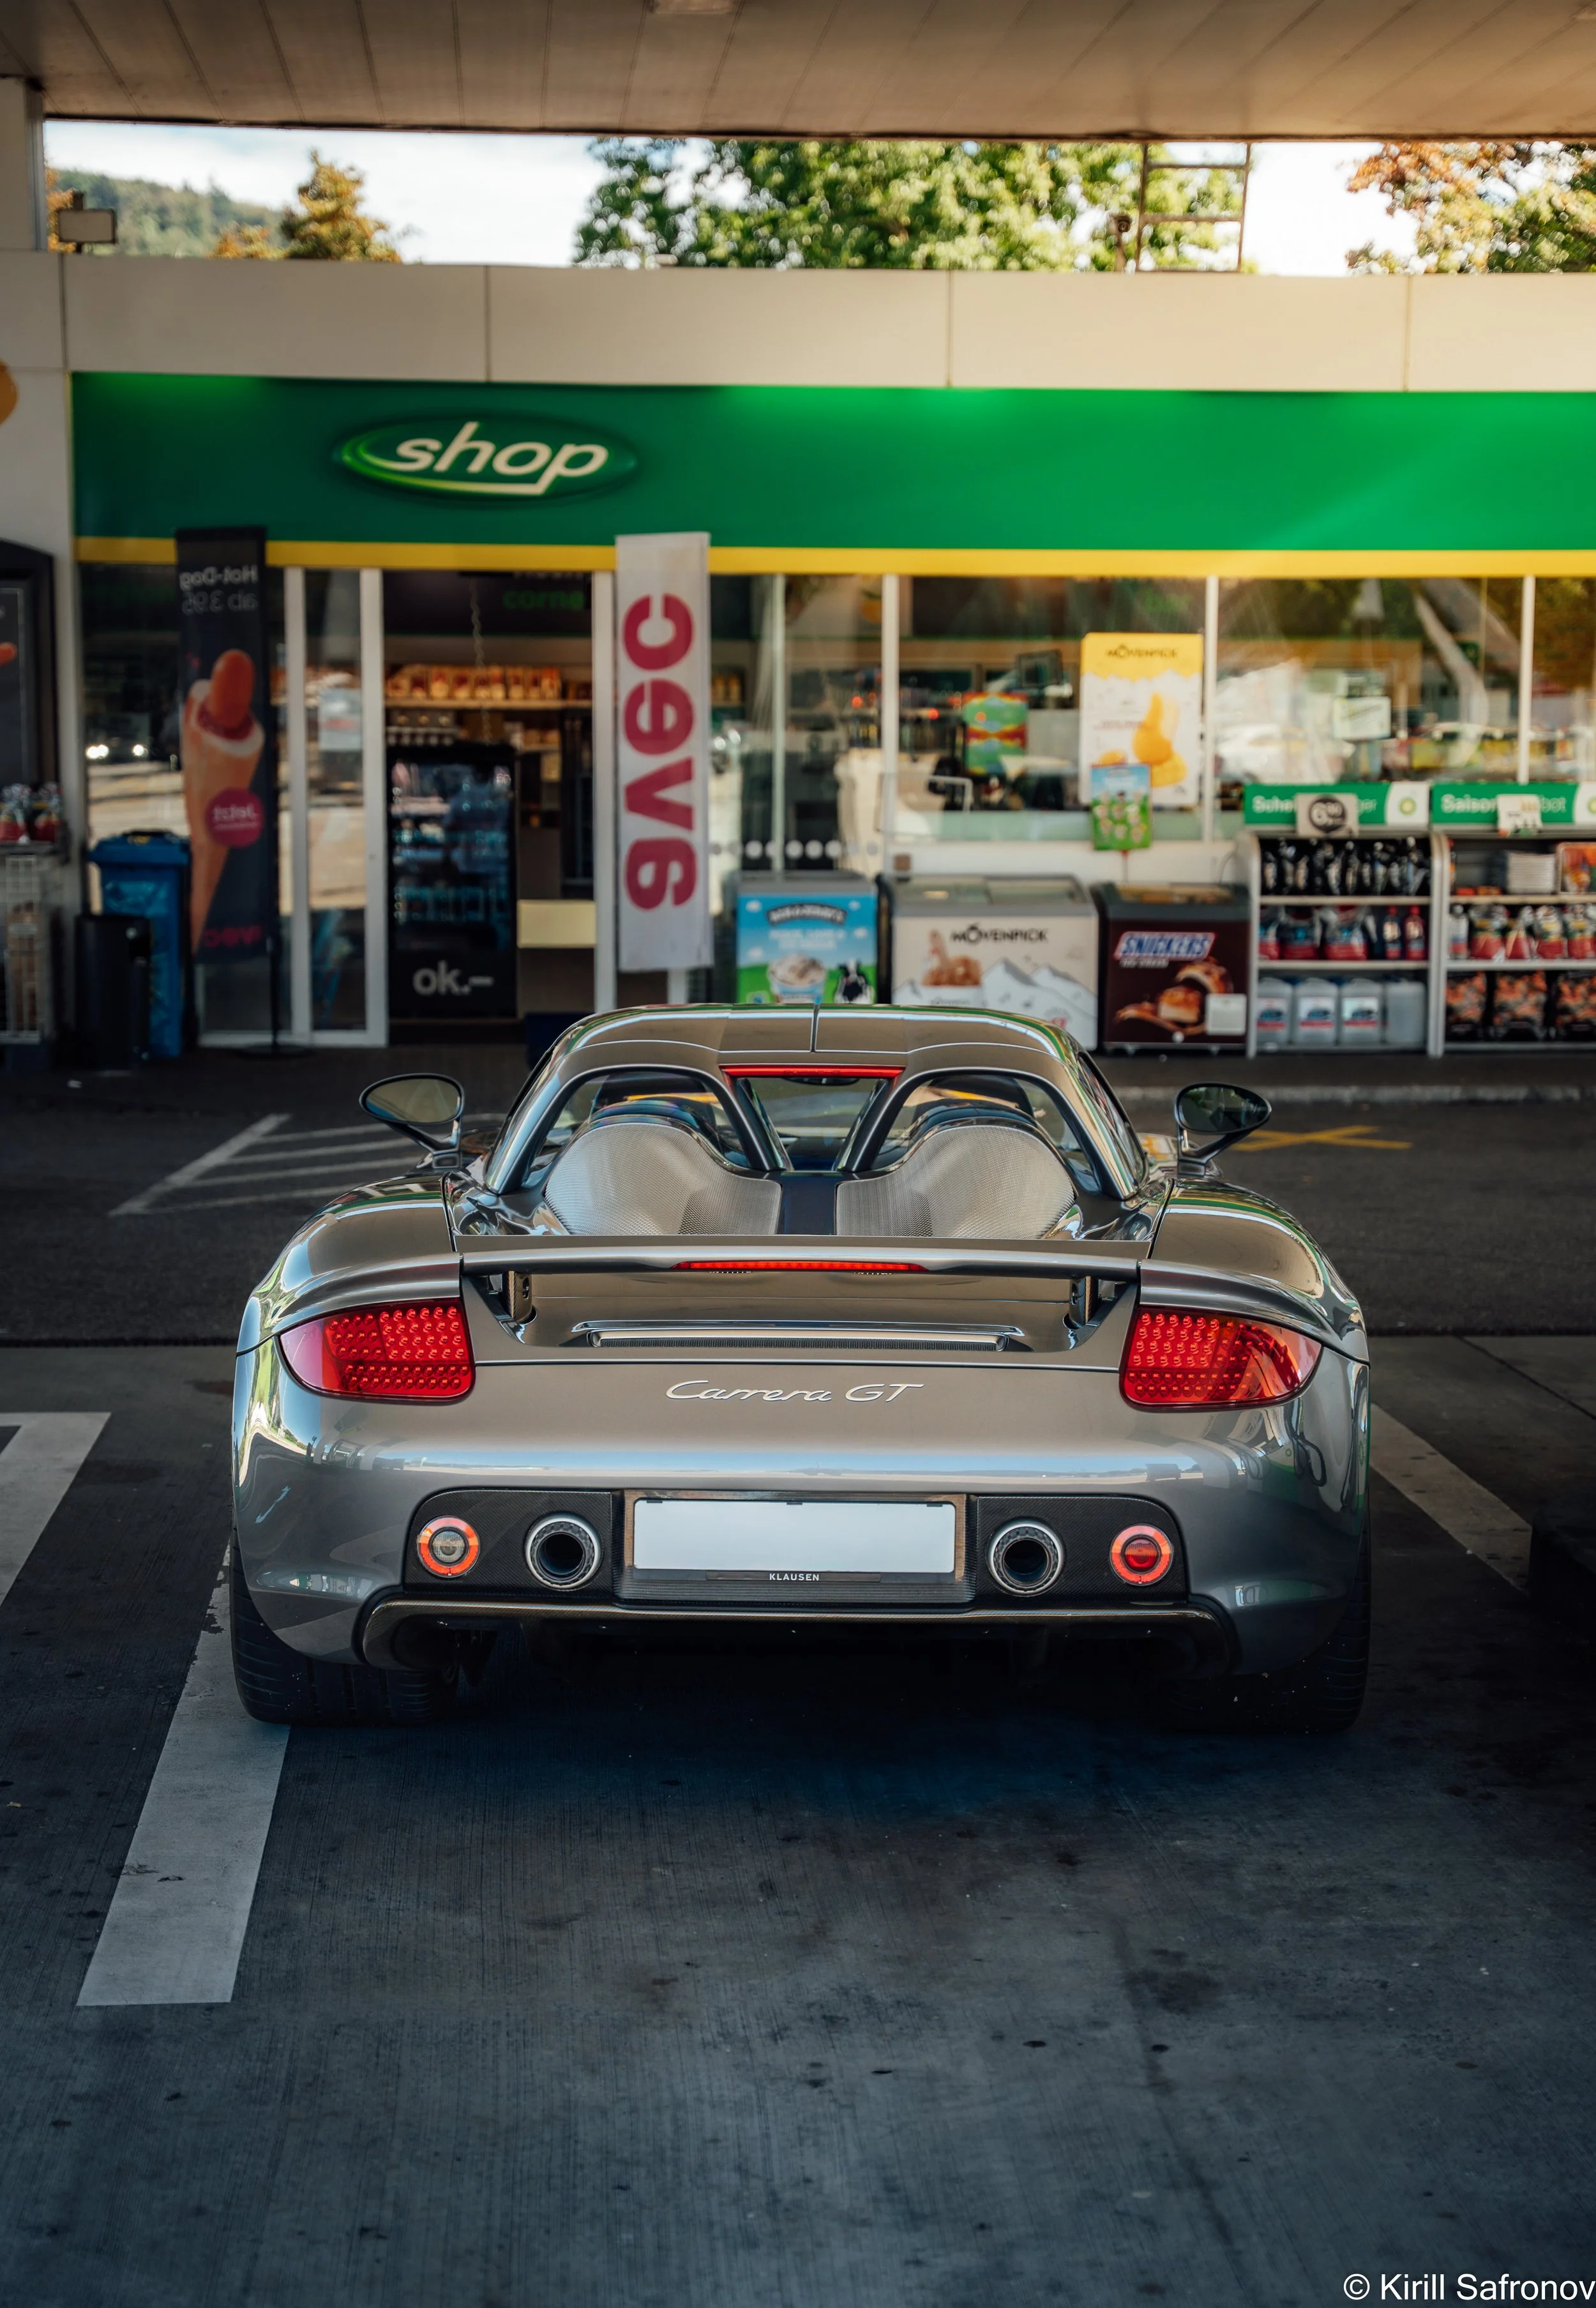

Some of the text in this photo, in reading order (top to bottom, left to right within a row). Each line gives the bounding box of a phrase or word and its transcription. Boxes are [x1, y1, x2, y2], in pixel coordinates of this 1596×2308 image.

[390, 421, 609, 495] shop
[1122, 935, 1209, 955] SNICKERS
[666, 1380, 924, 1403] Carrera GT
[769, 1573, 820, 1581] KLAUSEN
